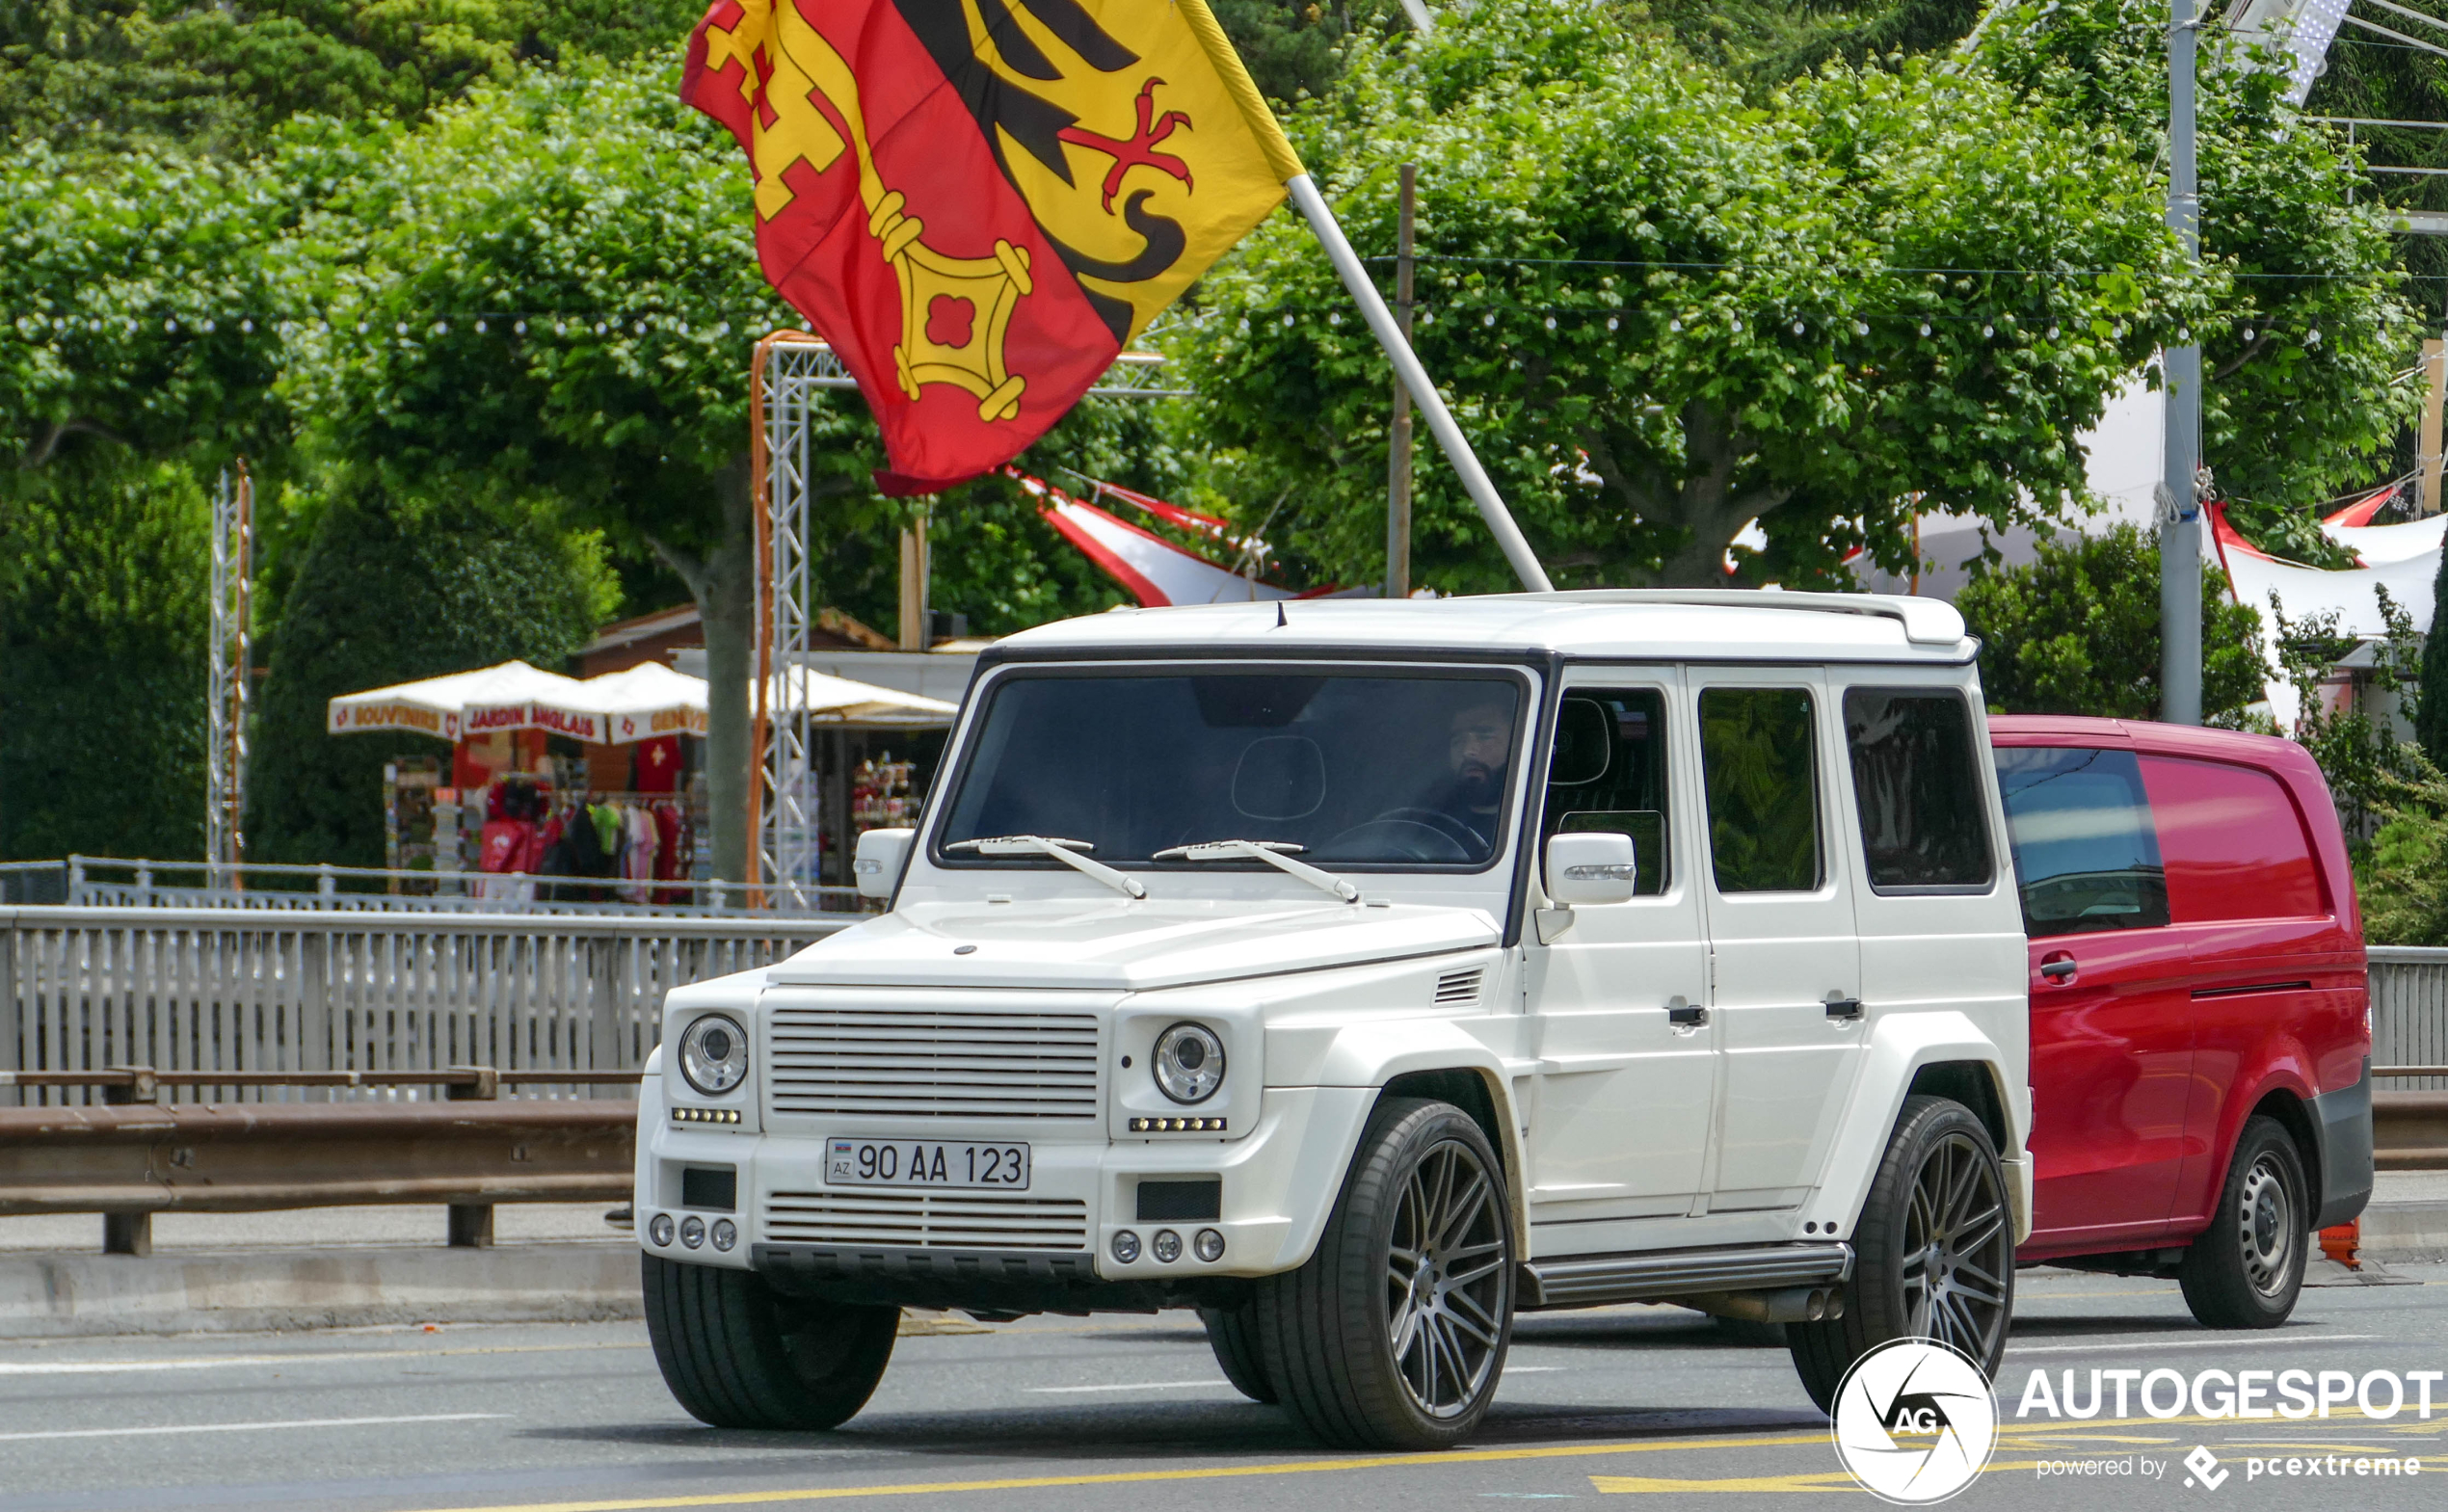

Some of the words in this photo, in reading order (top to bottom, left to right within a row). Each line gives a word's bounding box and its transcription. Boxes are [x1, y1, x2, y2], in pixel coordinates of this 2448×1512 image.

[355, 704, 440, 732] SOUVENIRS
[469, 704, 525, 729] JARDIN
[531, 703, 596, 737] ANGLAIS
[834, 1162, 850, 1176] AZ
[858, 1144, 898, 1180] 90
[909, 1145, 948, 1182] AA
[965, 1146, 1023, 1183] 123
